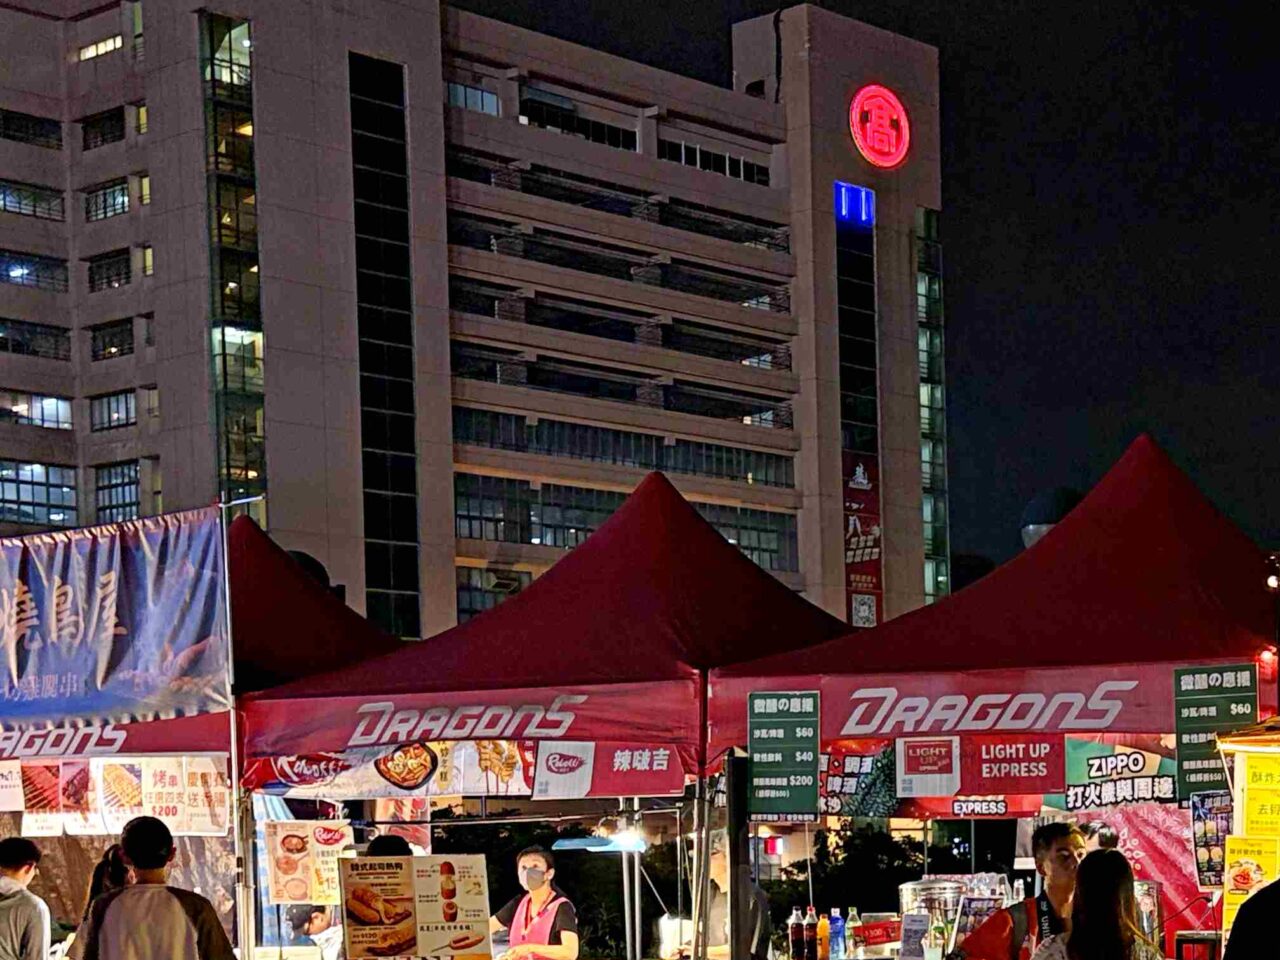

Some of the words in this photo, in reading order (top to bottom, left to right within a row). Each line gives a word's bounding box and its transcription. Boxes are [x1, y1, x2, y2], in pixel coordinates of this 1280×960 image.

[841, 680, 1139, 735] DRAGONS
[1230, 703, 1251, 714] $60
[348, 695, 588, 745] DRAGONS
[796, 727, 813, 737] $60
[0, 725, 127, 757] AGONS
[795, 751, 813, 761] $40
[909, 747, 947, 757] LIGHT
[982, 744, 1025, 759] LIGHT
[1030, 743, 1050, 757] UP
[613, 748, 670, 771] 辣啵吉
[1088, 753, 1144, 777] ZIPPO
[982, 763, 1047, 777] EXPRESS
[790, 775, 813, 786] $200
[1067, 777, 1173, 808] 打火機與周邊
[151, 806, 177, 816] $200
[954, 802, 1005, 813] EXPRESS
